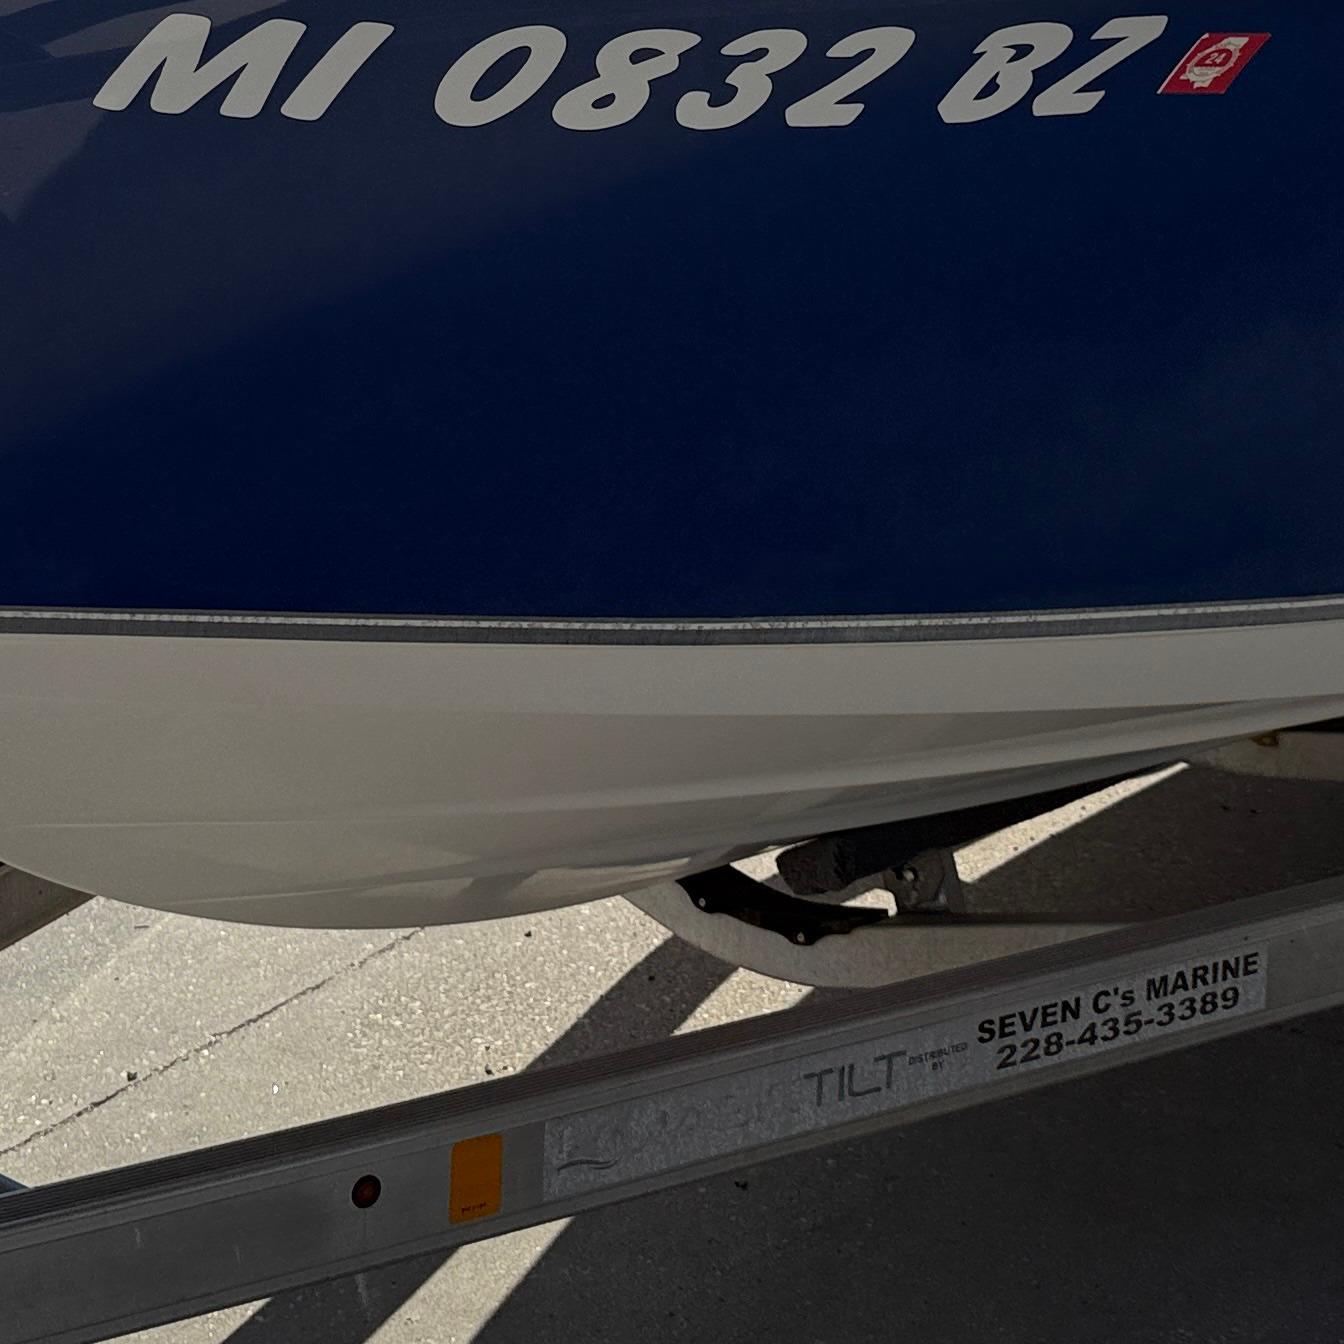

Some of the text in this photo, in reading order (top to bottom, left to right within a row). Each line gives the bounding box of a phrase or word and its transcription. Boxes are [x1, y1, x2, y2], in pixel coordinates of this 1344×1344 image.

[93, 13, 1168, 130] MI 0832 BZ
[977, 951, 1260, 1044] SEVEN C's MARINE
[995, 985, 1241, 1071] 228-435-3389
[803, 1049, 907, 1107] TILT
[908, 1041, 968, 1066] DISTRIBUTED
